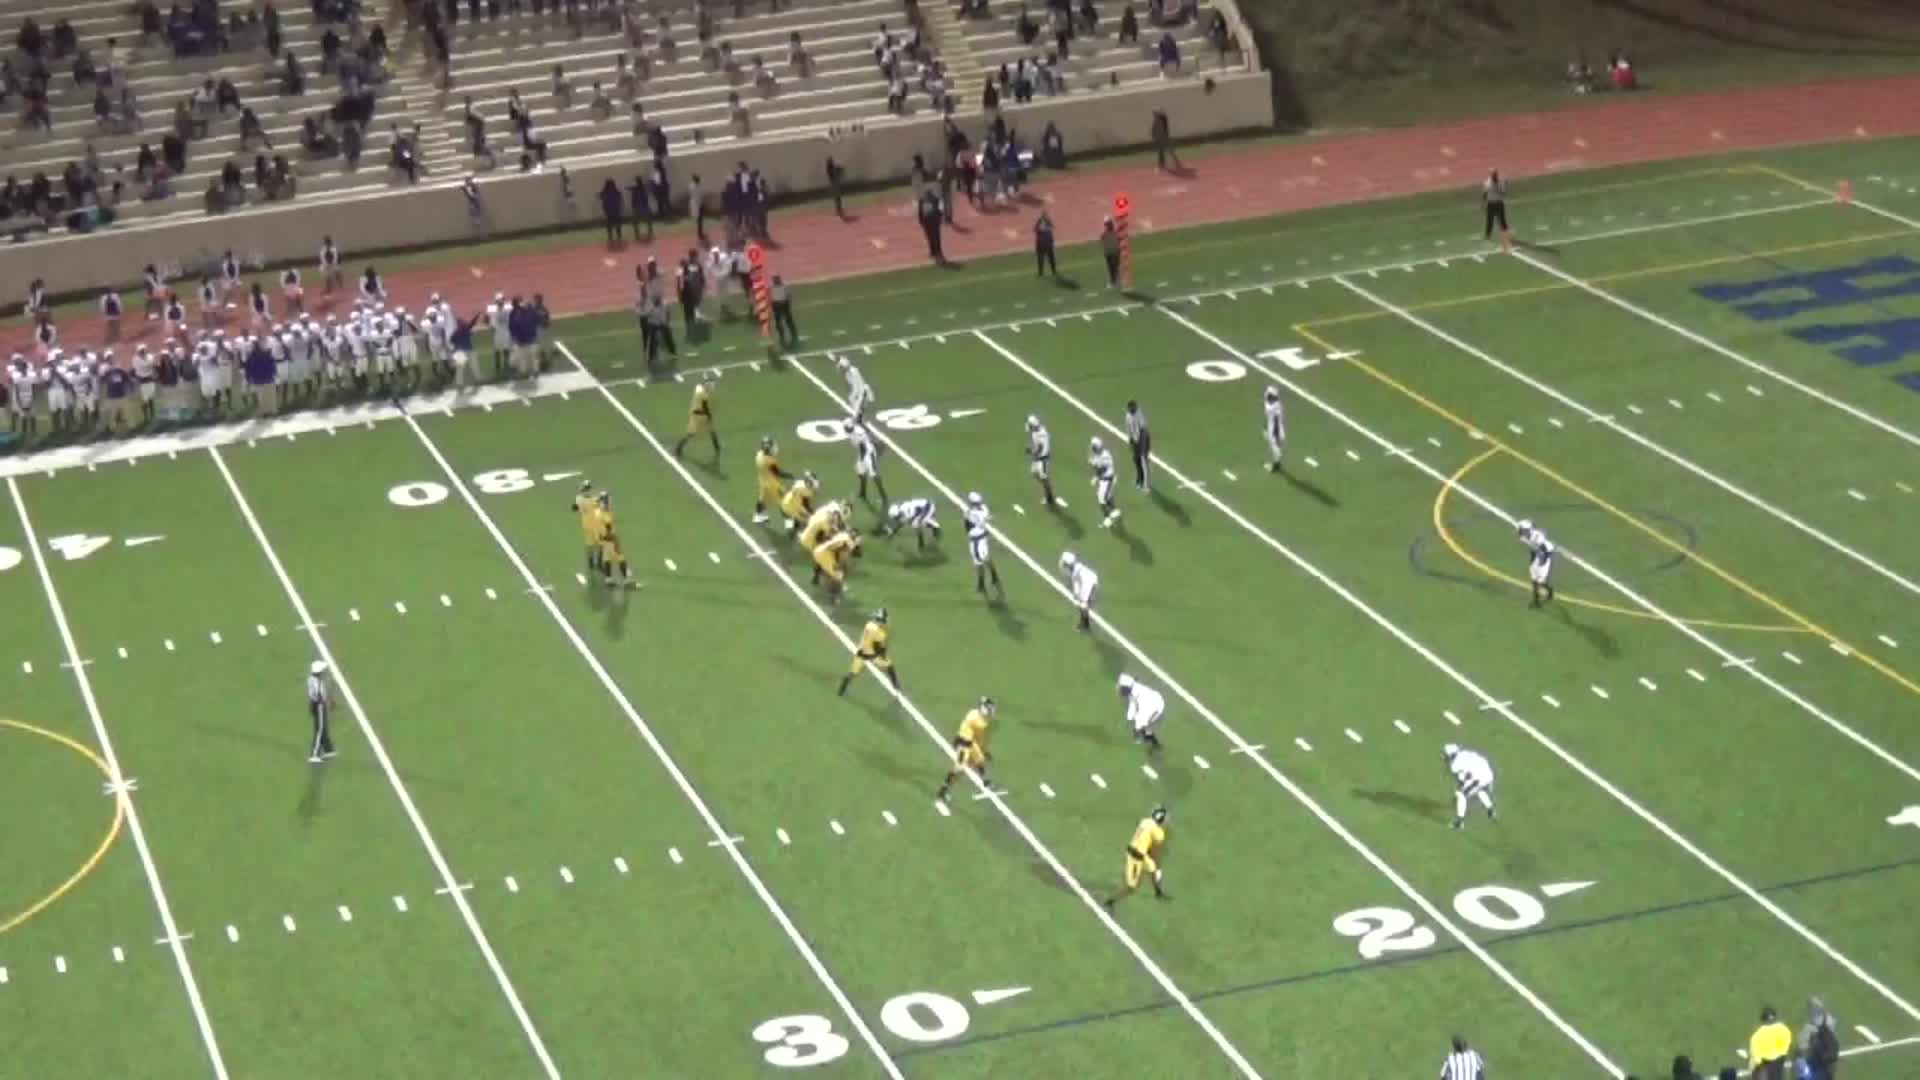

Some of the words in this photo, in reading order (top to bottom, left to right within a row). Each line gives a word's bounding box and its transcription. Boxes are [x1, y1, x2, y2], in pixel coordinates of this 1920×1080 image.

[1185, 347, 1321, 381] 10
[796, 404, 942, 442] 20
[388, 468, 535, 506] 30
[1332, 885, 1545, 960] 20
[752, 991, 971, 1067] 30
